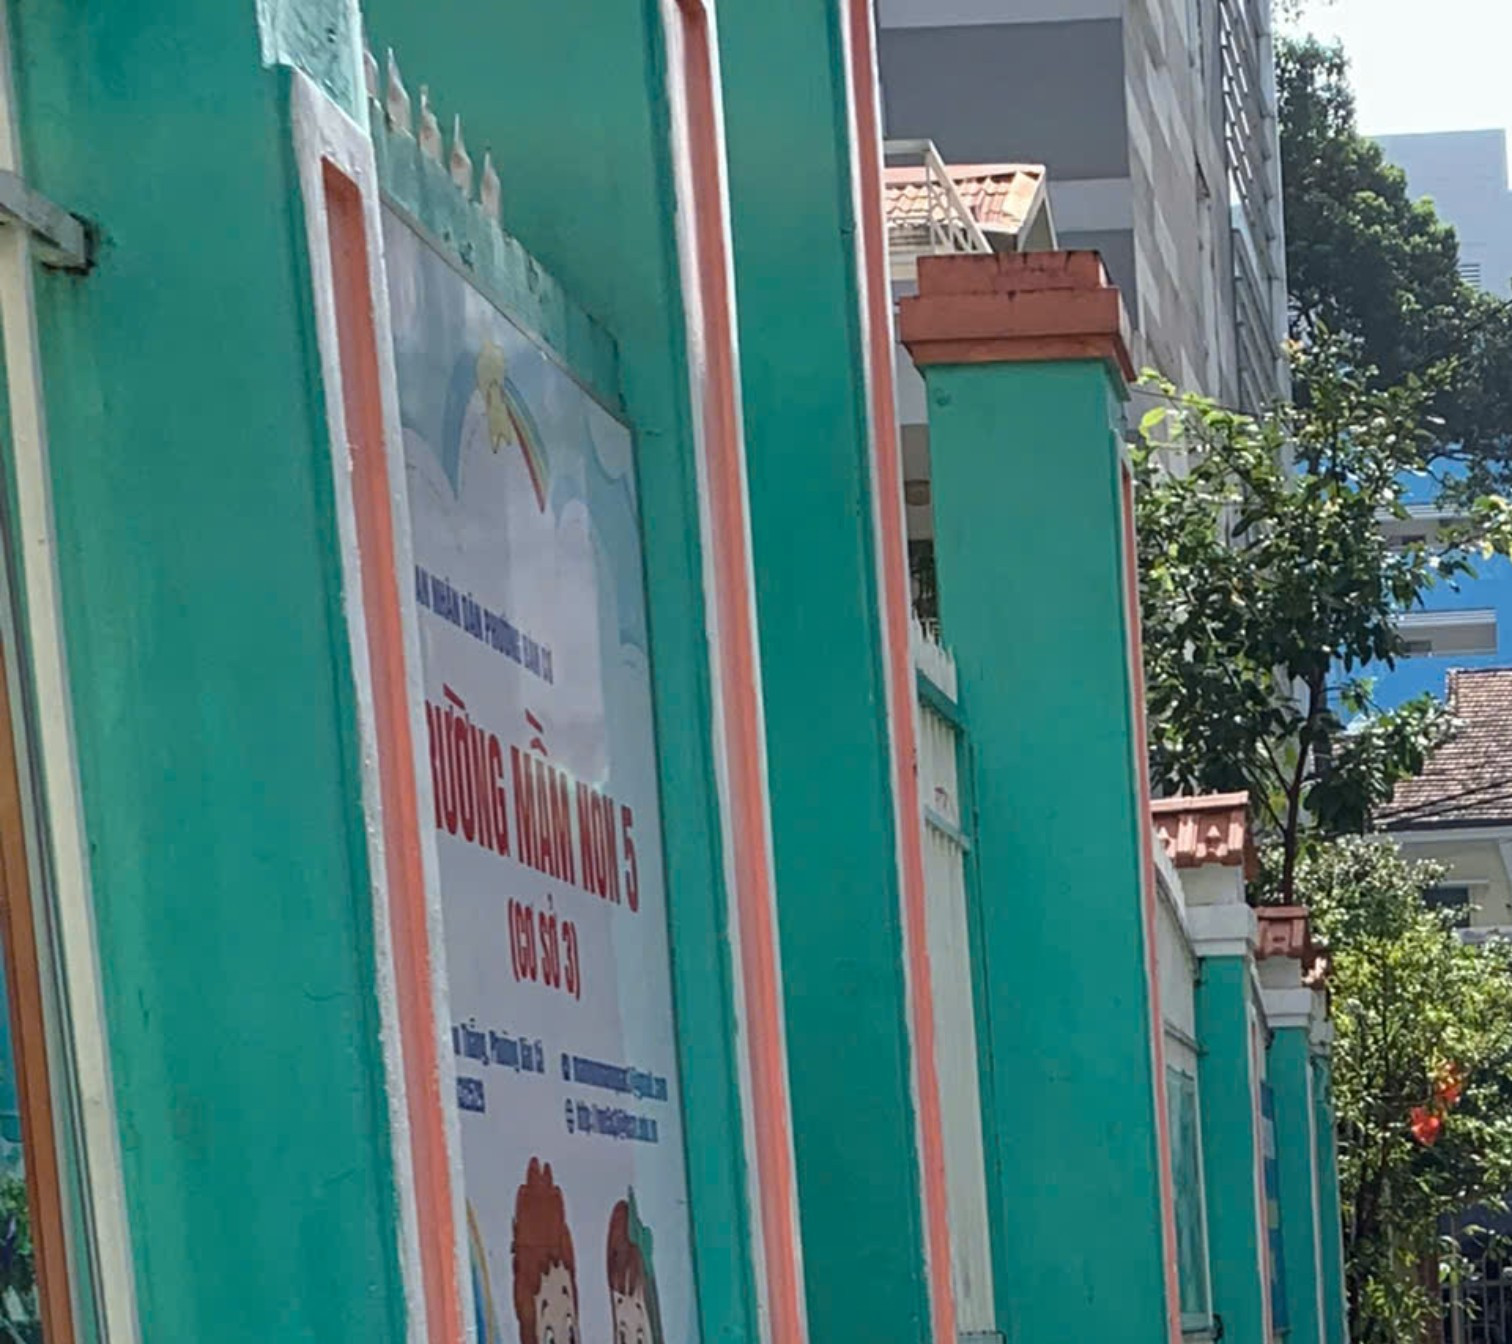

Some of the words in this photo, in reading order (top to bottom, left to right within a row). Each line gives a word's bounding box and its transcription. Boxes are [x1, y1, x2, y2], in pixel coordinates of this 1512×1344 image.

[510, 707, 576, 886] MẦM
[576, 780, 621, 905] NON
[620, 803, 640, 913] 5
[562, 920, 581, 1002] 3)
